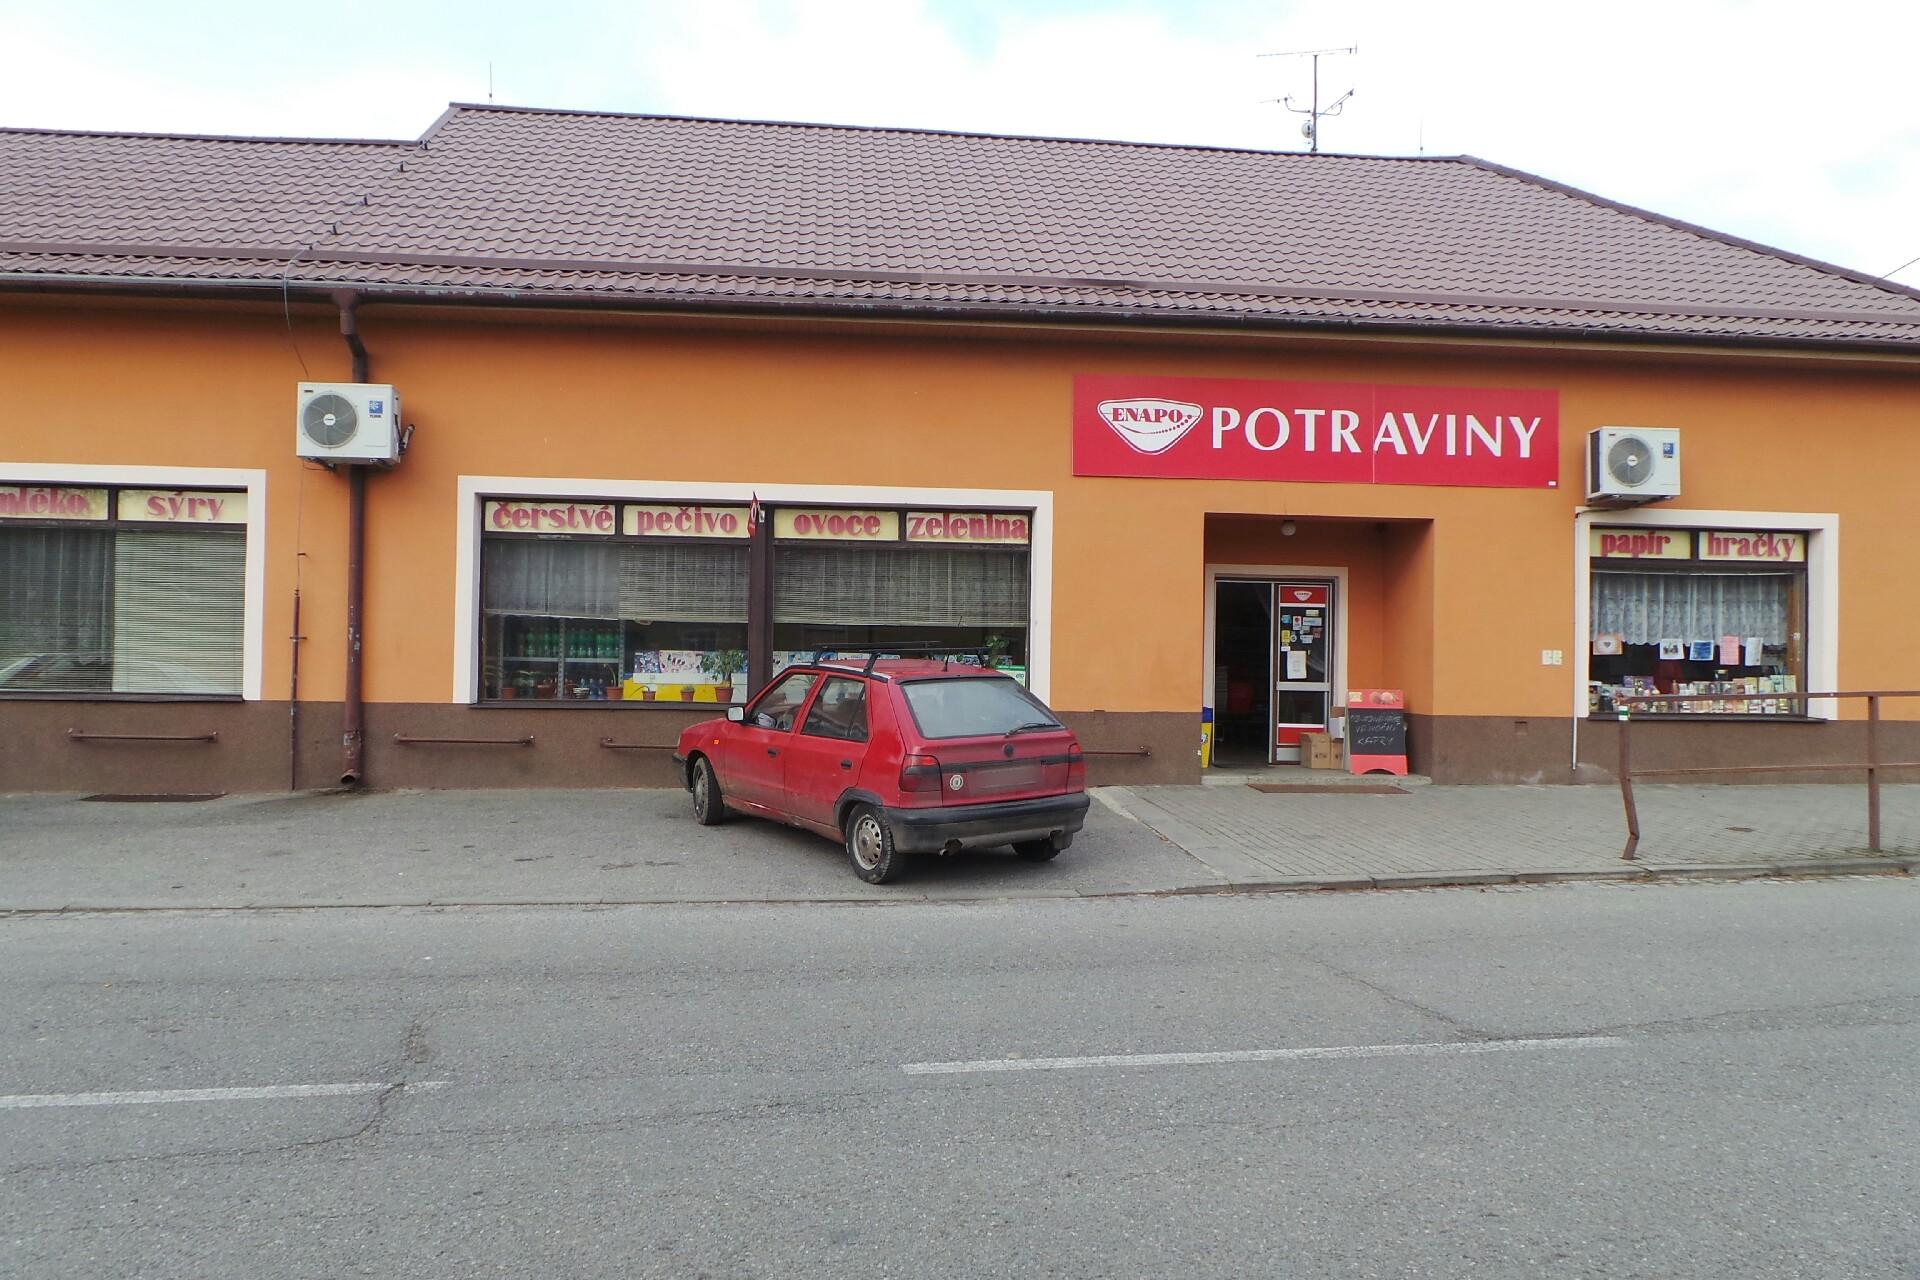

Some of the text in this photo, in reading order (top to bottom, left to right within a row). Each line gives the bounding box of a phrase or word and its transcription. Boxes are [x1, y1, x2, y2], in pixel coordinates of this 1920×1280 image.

[1112, 407, 1541, 458] ENAPO POTRAVINY
[147, 491, 224, 520] sýry
[493, 501, 737, 536] čerstvé pečivo
[794, 514, 880, 536] ovoce
[908, 512, 1027, 539] zelenina
[1601, 530, 1671, 557] papír
[1708, 530, 1795, 561] hračky
